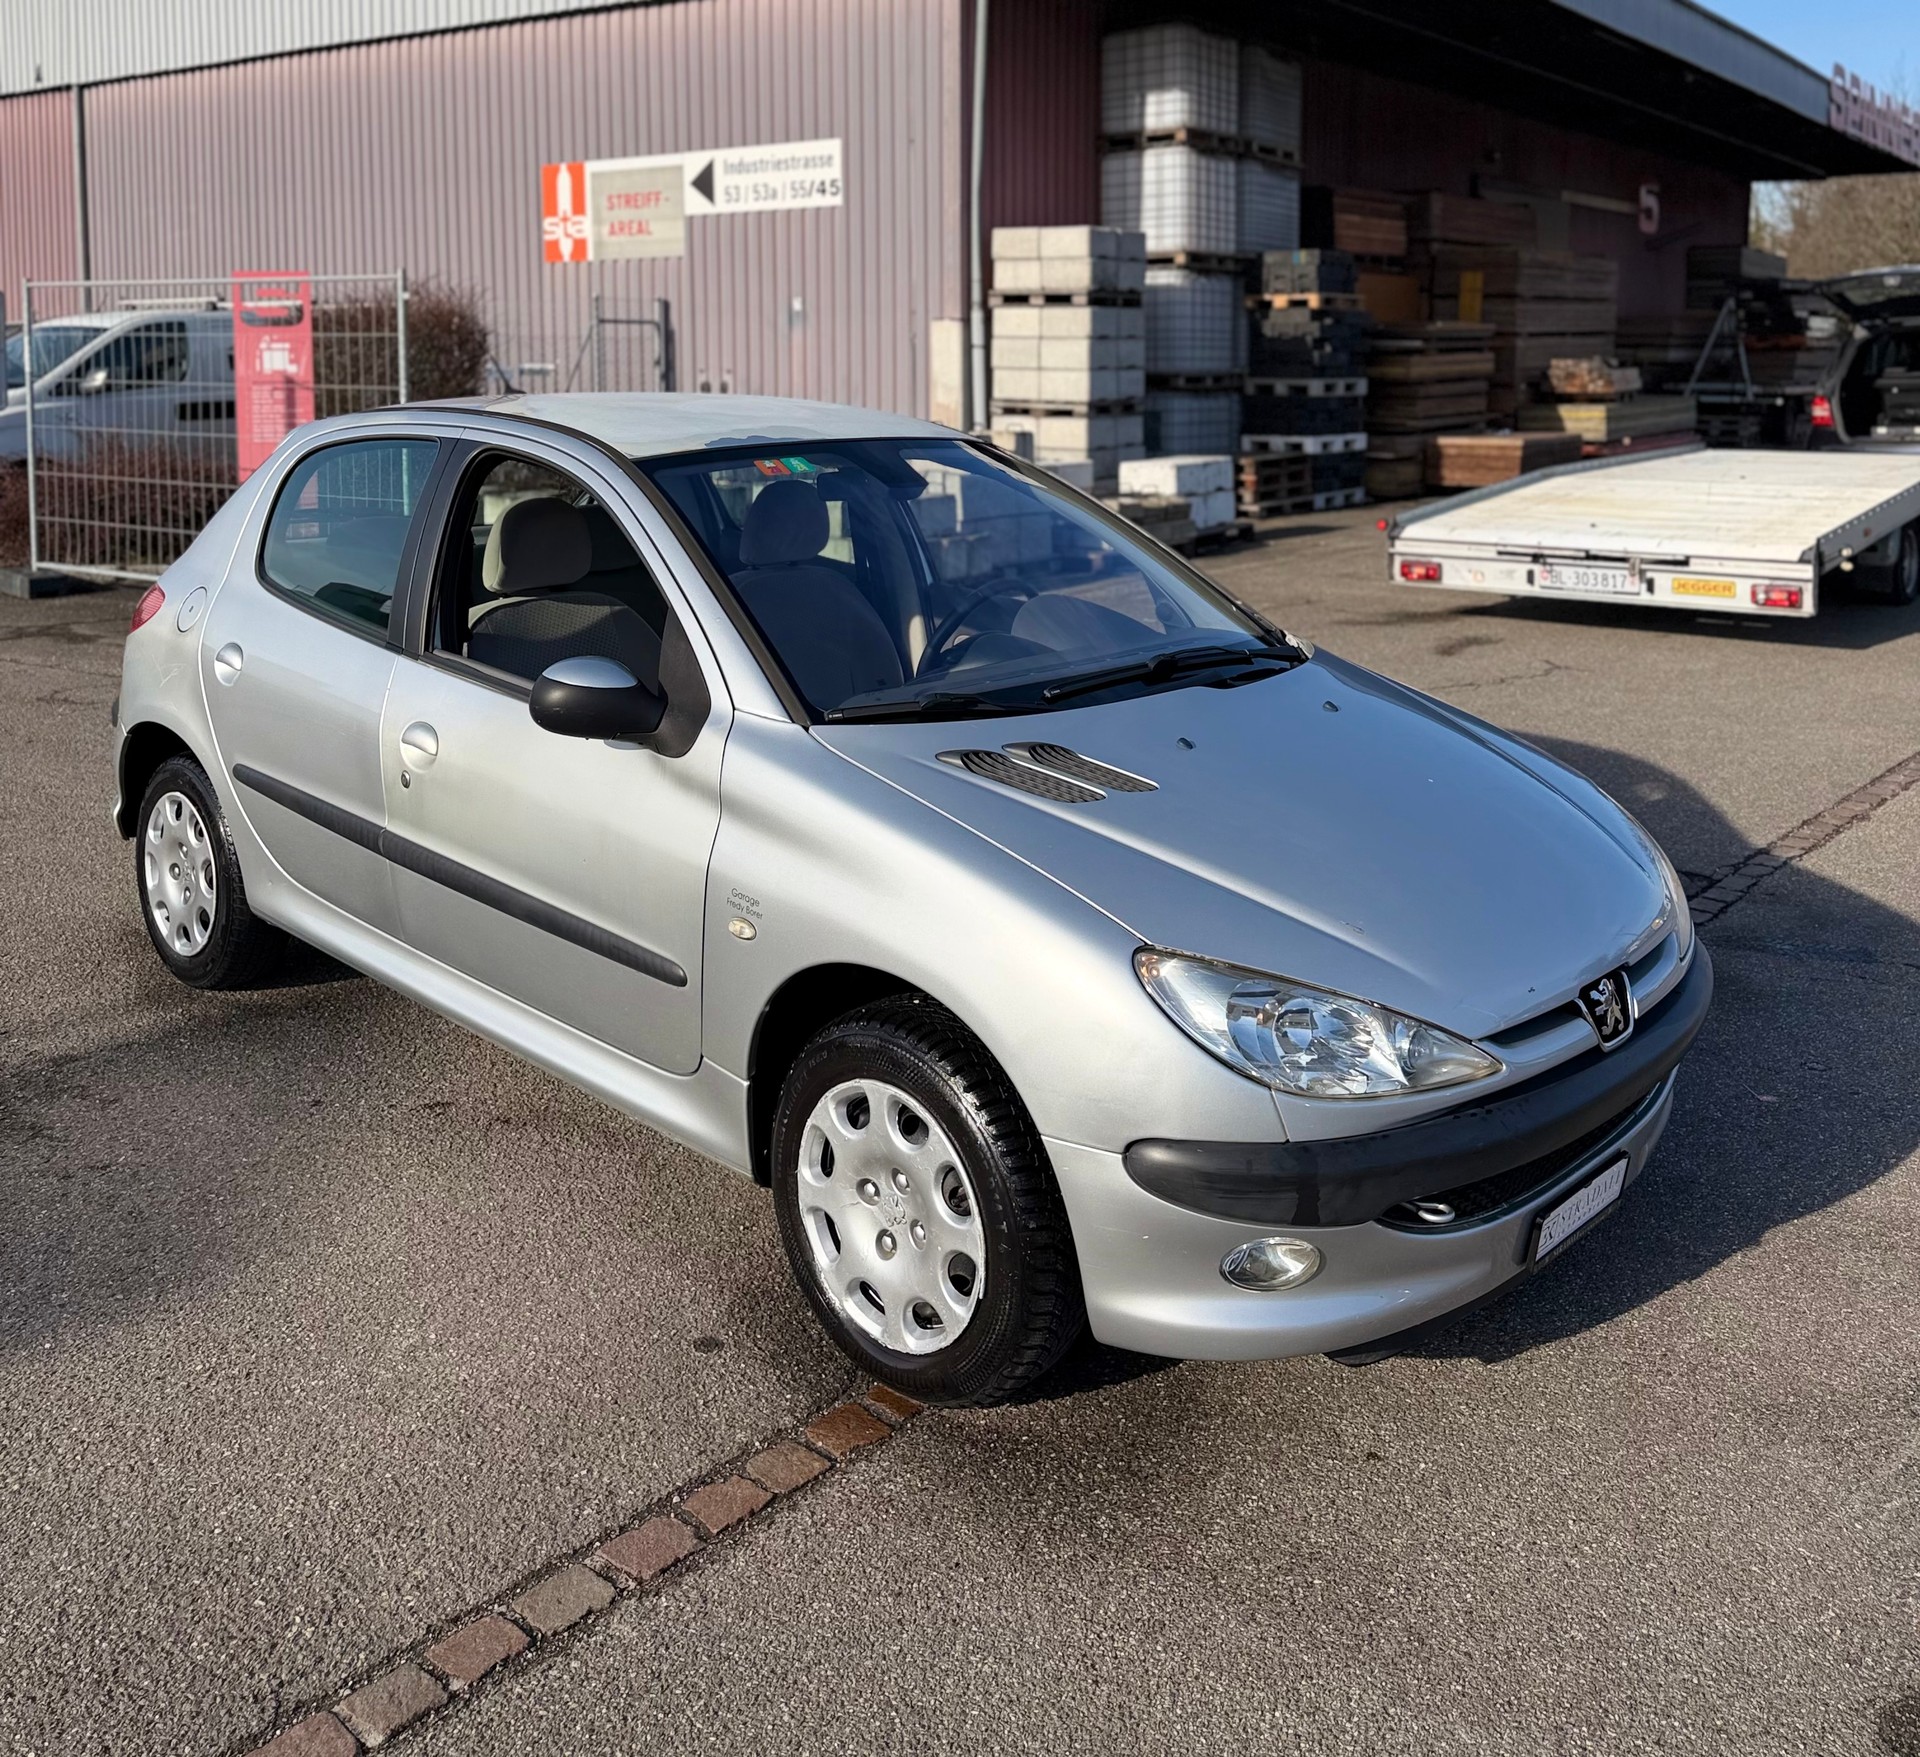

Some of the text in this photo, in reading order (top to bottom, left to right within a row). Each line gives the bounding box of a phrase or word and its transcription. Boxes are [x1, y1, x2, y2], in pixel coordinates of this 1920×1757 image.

[723, 154, 833, 175] Industriestrasse
[724, 184, 741, 203] 53
[752, 182, 778, 202] 53a
[1639, 185, 1660, 233] 5
[608, 219, 653, 236] AREAL
[726, 897, 745, 913] Fredy
[731, 888, 760, 907] Garage
